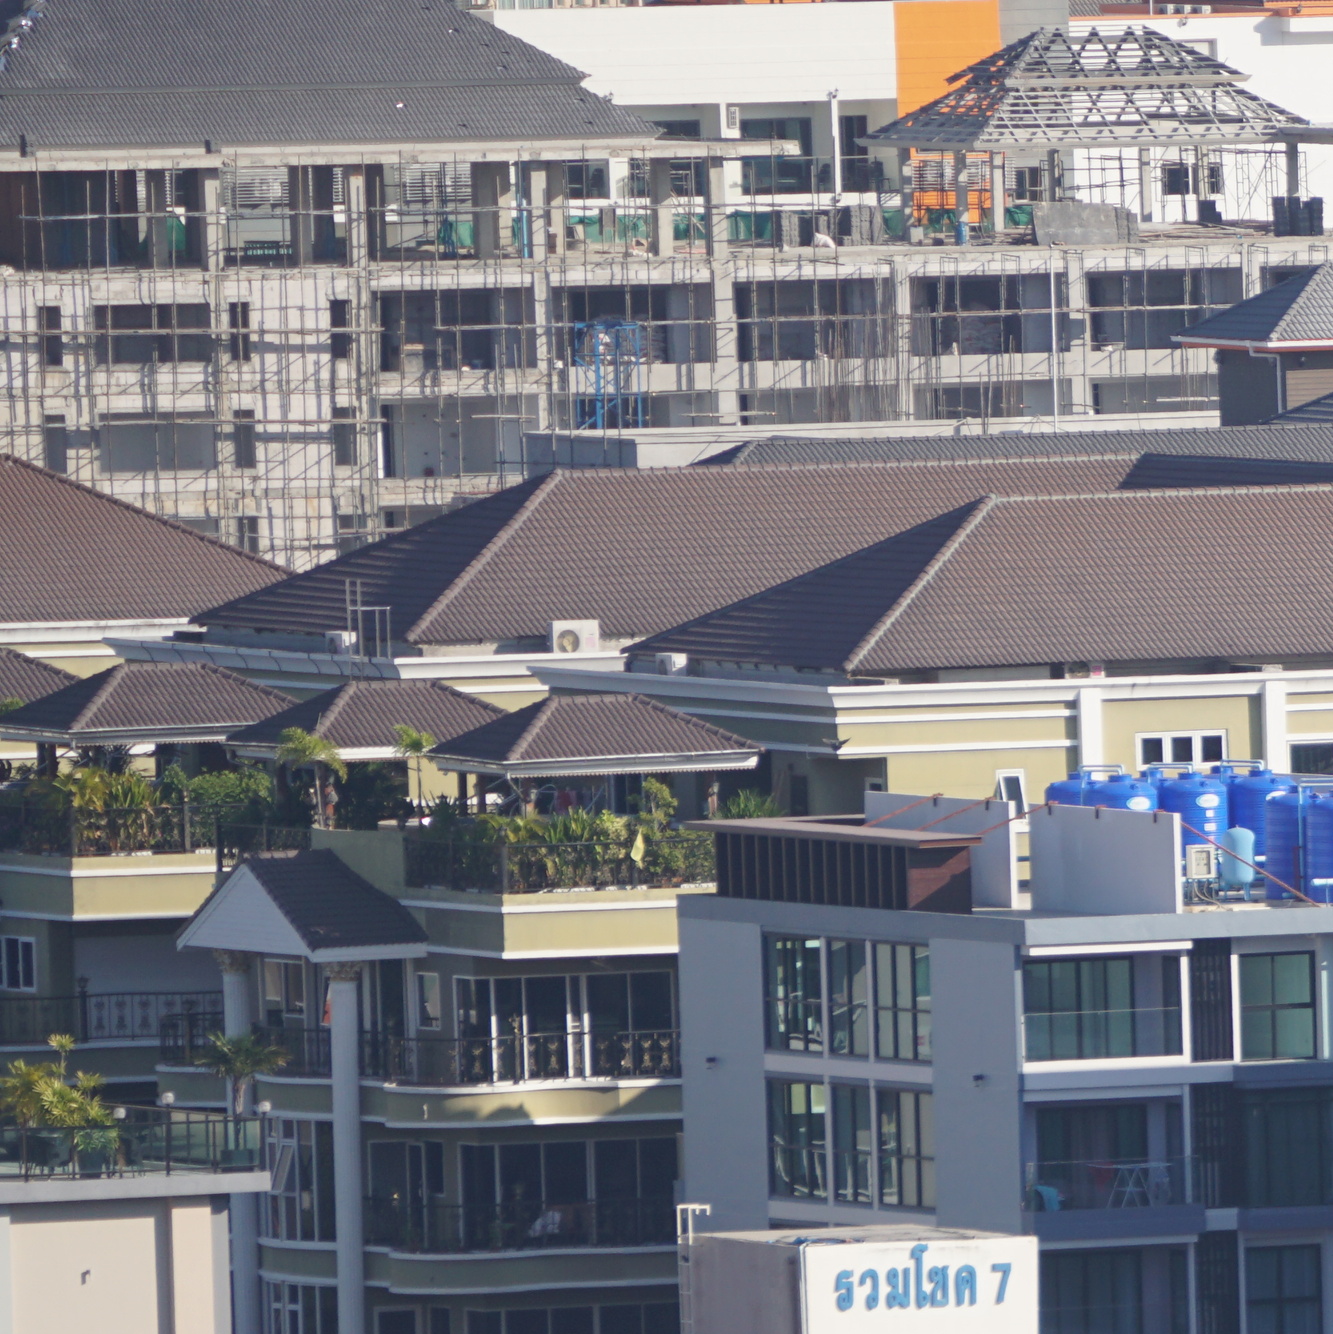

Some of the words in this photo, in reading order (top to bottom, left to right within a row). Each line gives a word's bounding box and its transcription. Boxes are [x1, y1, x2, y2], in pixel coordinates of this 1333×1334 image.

[835, 1243, 977, 1311] รวมโชค
[991, 1262, 1012, 1305] 7
